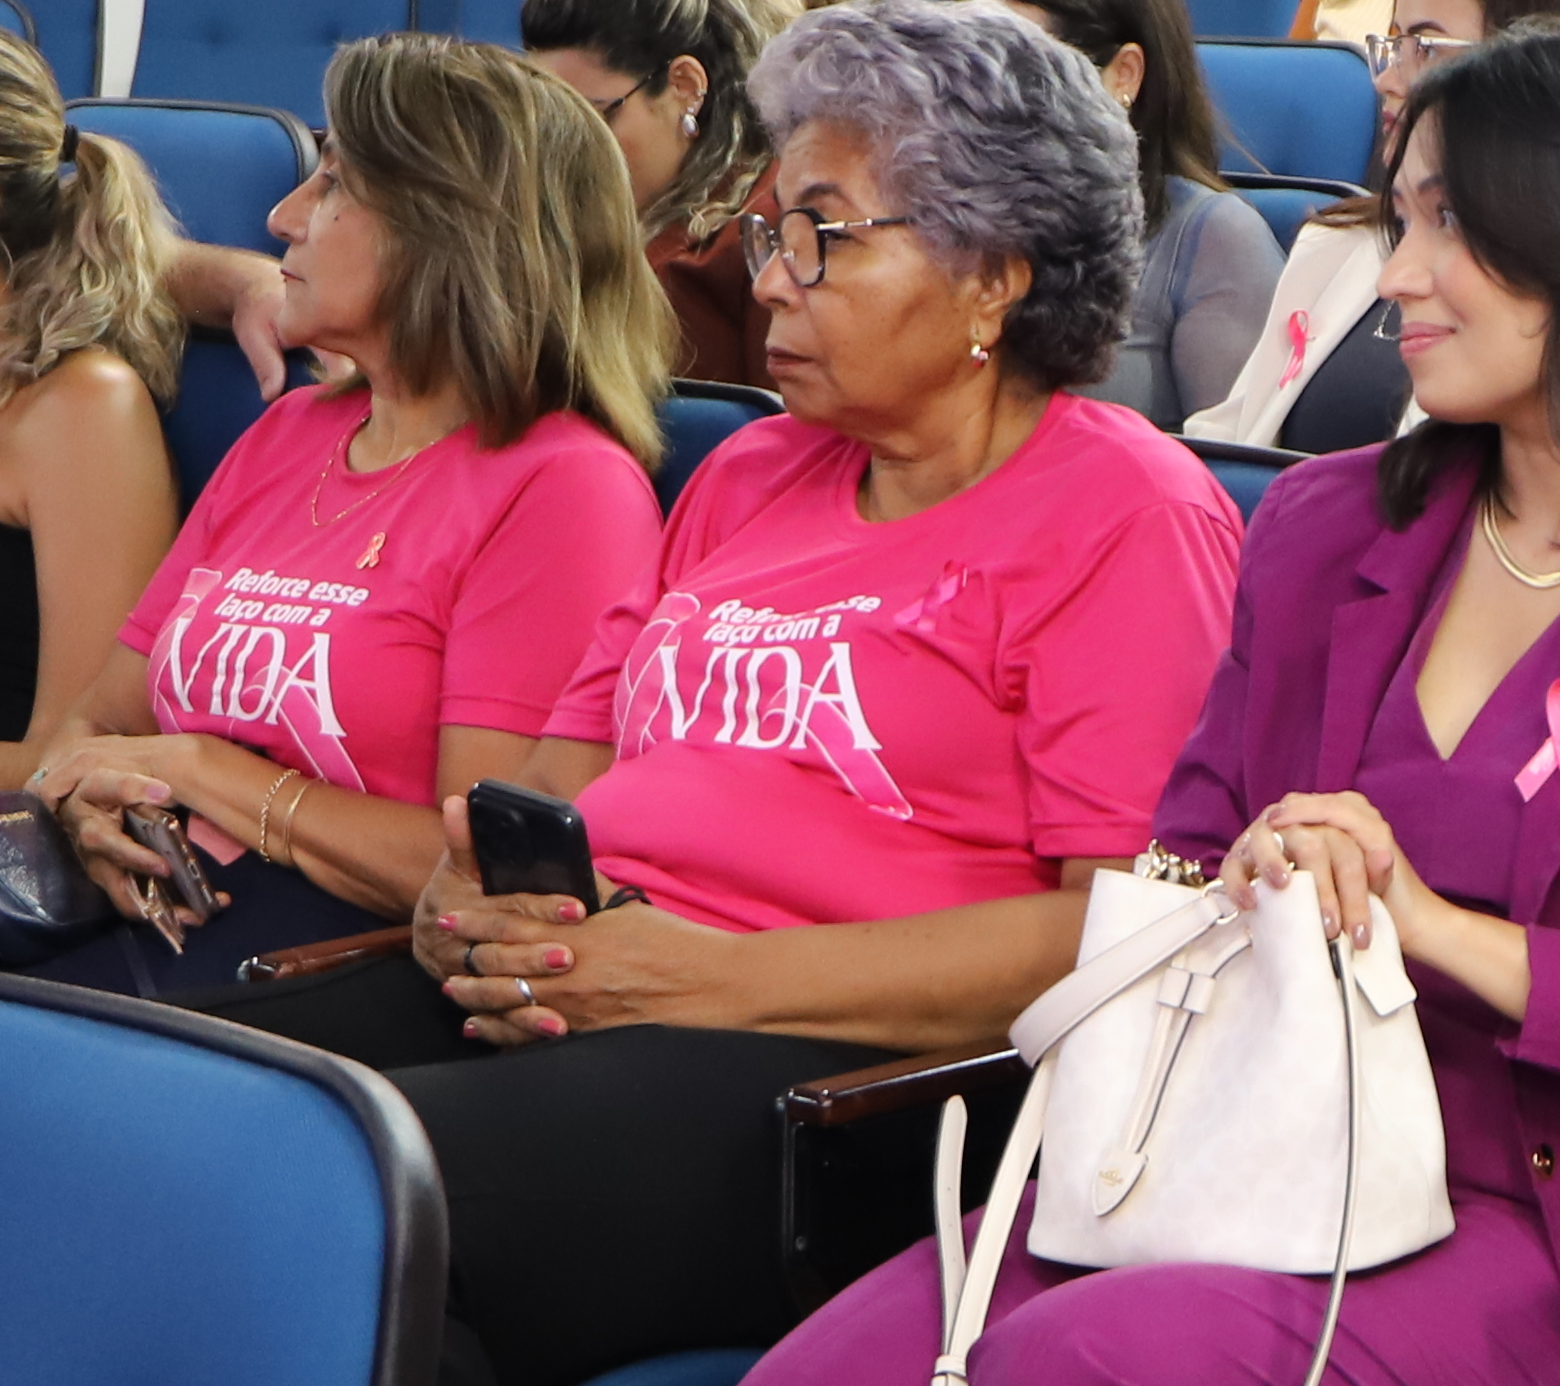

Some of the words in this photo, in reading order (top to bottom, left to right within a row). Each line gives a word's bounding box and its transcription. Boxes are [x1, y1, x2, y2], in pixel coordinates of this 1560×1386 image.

[224, 567, 311, 598] Reforce
[308, 581, 370, 607] esse
[214, 593, 265, 623] laço
[262, 603, 313, 624] com
[309, 608, 332, 627] a
[702, 622, 762, 648] laço
[763, 616, 822, 643] com
[822, 613, 842, 638] a
[167, 616, 347, 738] VIDA
[659, 641, 883, 751] VIDA
